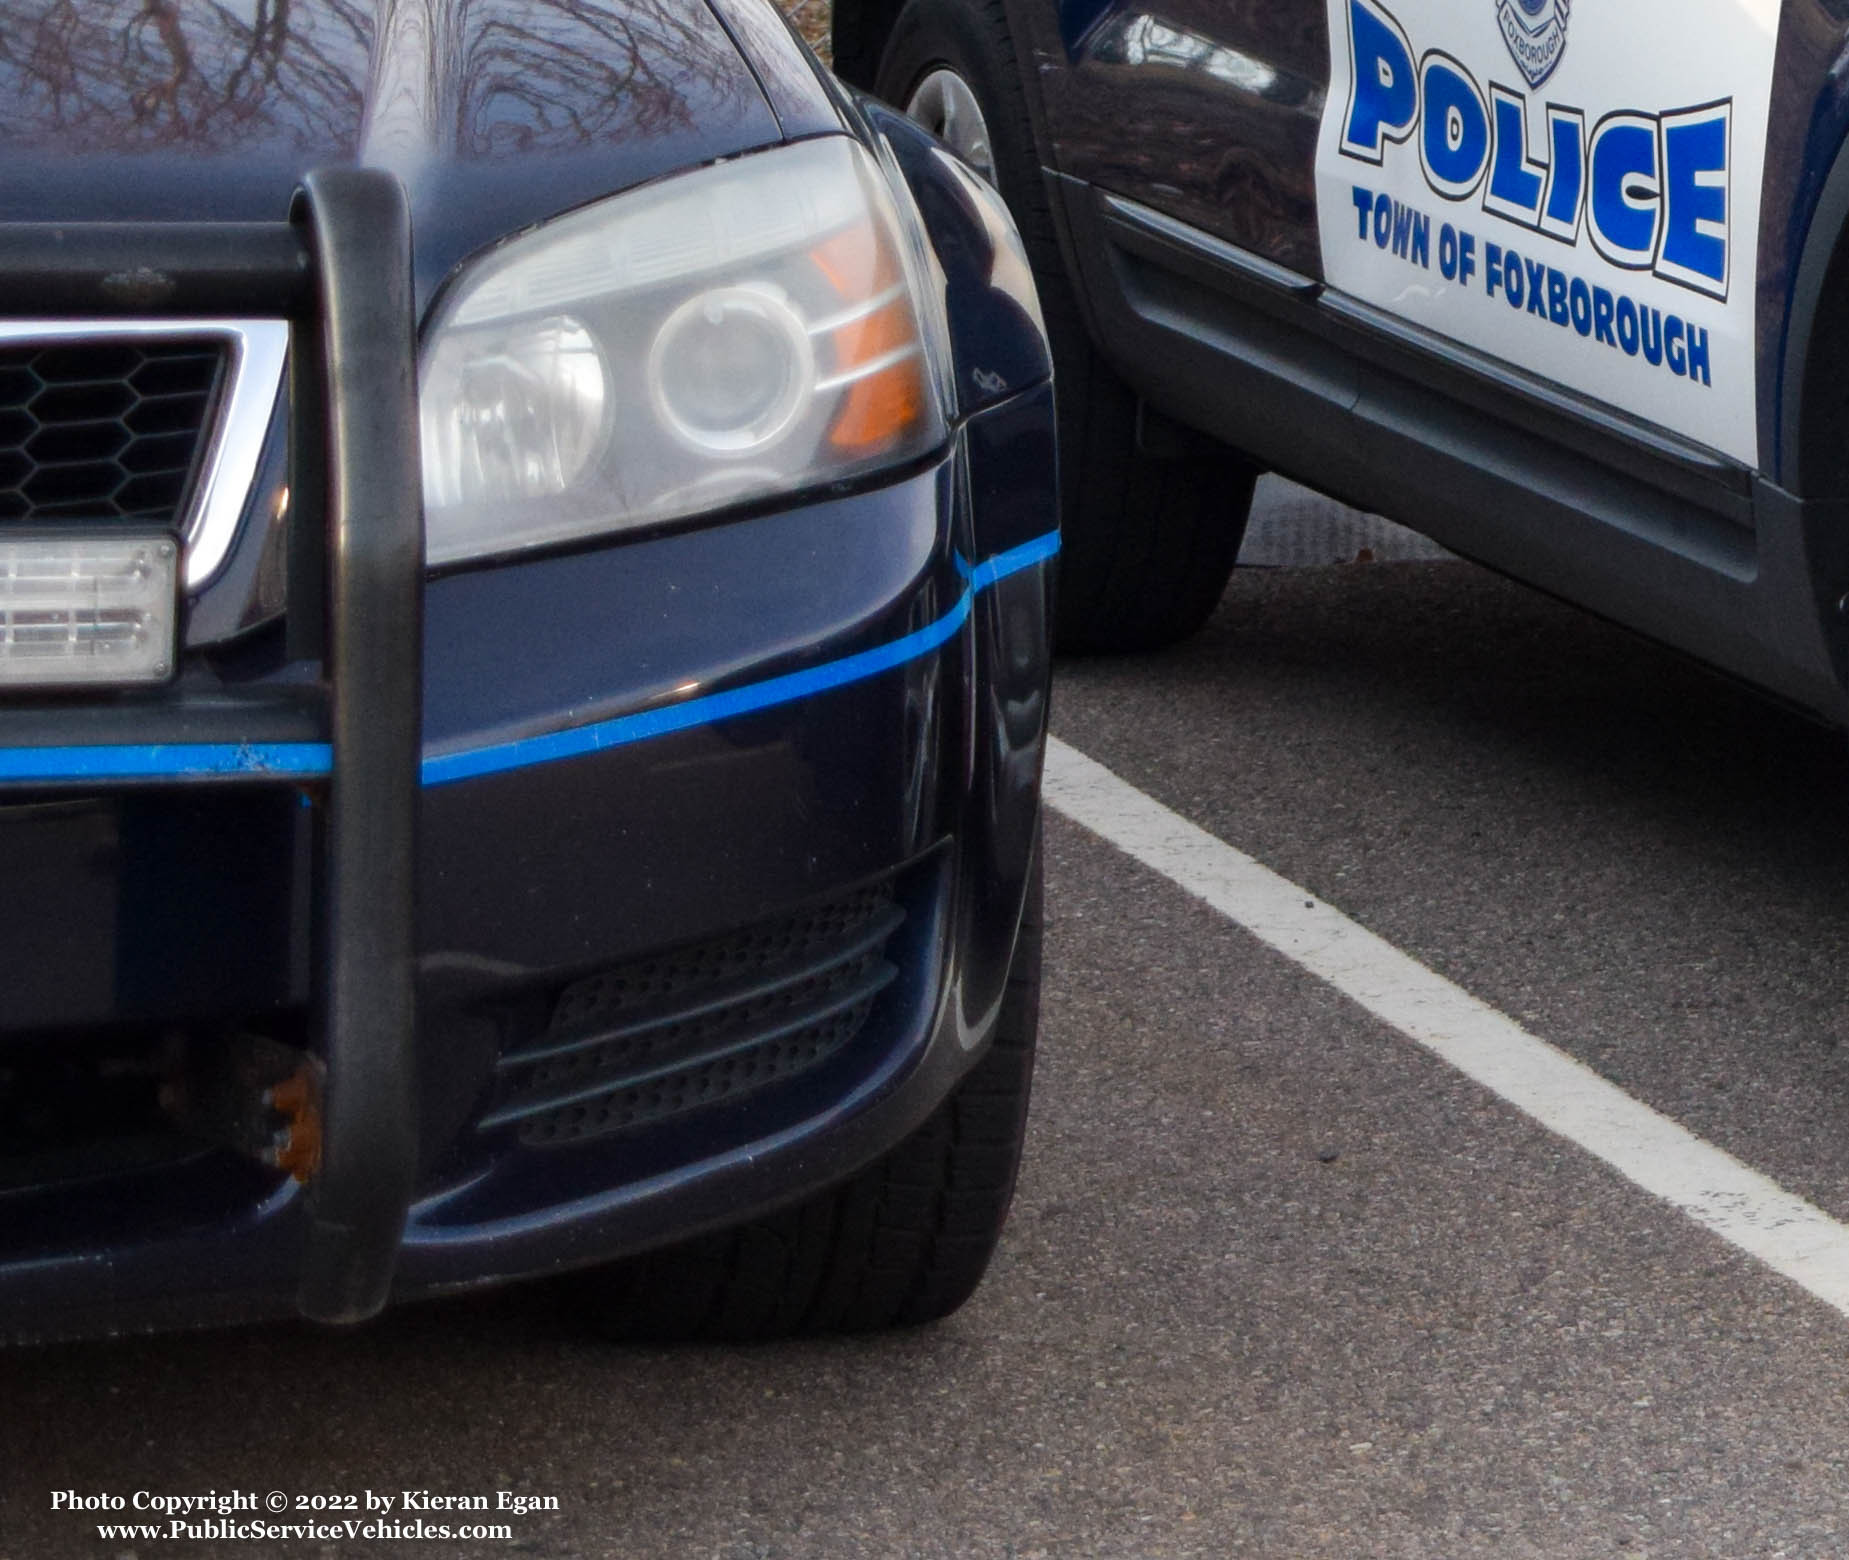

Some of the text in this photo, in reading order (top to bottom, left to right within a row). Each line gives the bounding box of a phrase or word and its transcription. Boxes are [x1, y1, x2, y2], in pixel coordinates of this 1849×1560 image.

[1502, 12, 1561, 65] FOXBOROUGH
[1352, 186, 1712, 386] TOWN OF FOXBOROUGH
